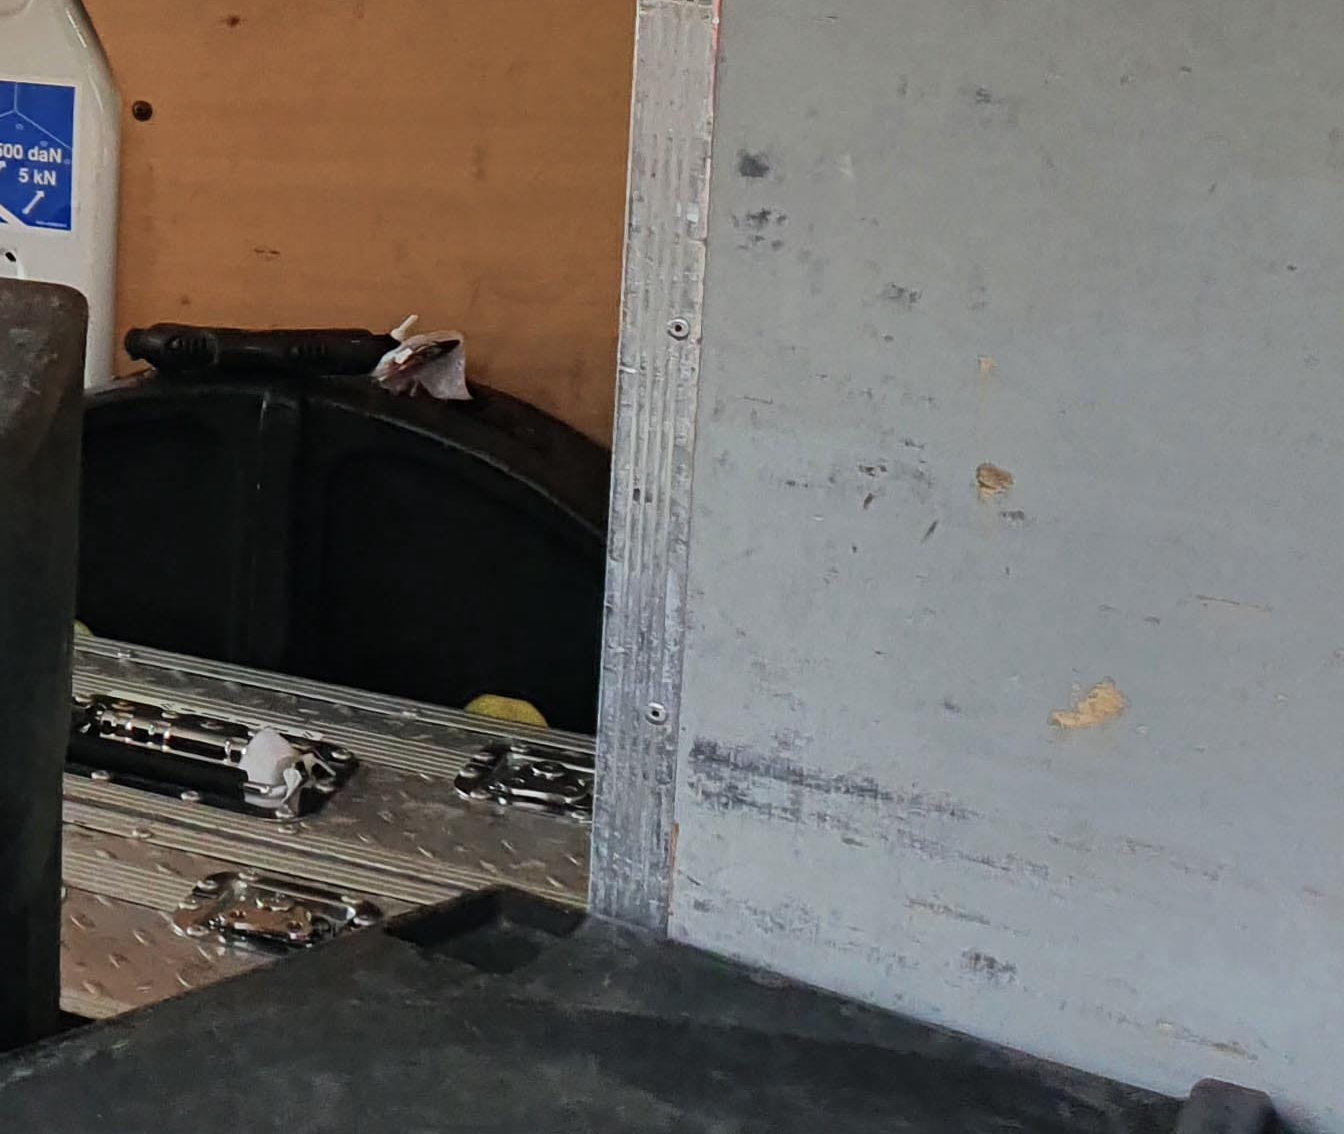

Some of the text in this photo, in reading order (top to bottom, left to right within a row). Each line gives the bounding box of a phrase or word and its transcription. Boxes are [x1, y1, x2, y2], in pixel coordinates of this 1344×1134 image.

[27, 146, 62, 164] daN
[18, 167, 57, 186] 5 kN
